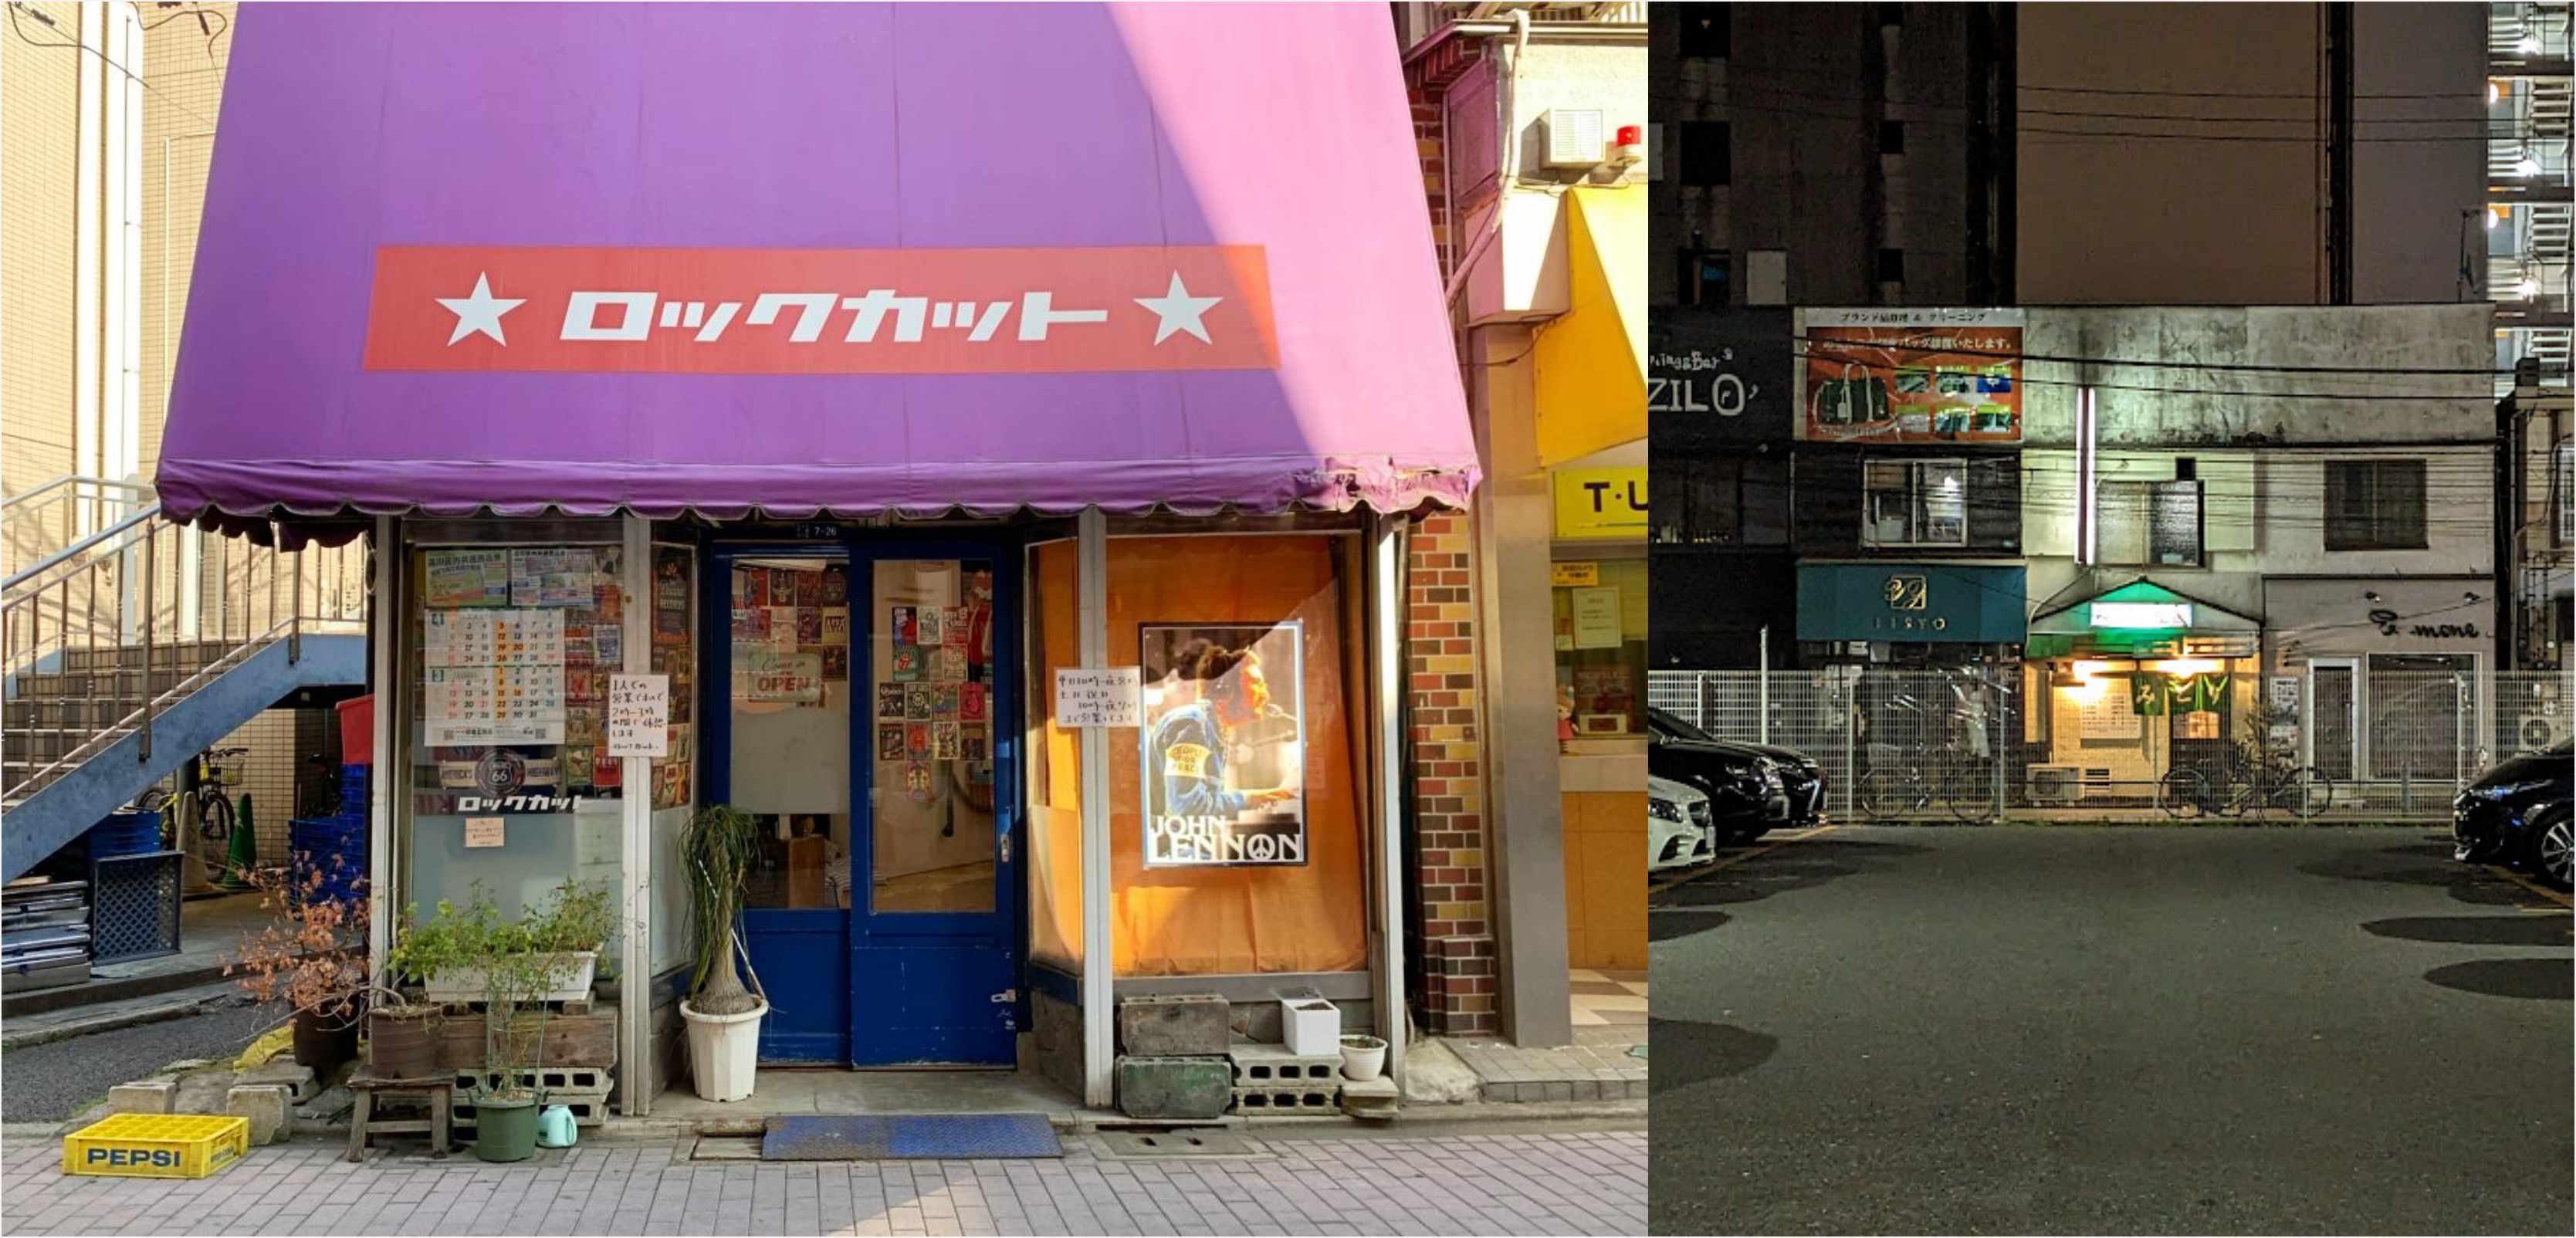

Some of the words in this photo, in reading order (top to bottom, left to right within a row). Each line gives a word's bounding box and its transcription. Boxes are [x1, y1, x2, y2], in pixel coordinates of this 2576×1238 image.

[560, 289, 1108, 343] ロックカット
[757, 677, 809, 692] OPEN
[492, 772, 509, 783] 66
[1150, 815, 1228, 837] JOHN
[1150, 833, 1302, 861] LENNON
[86, 1148, 181, 1168] PEPSI
